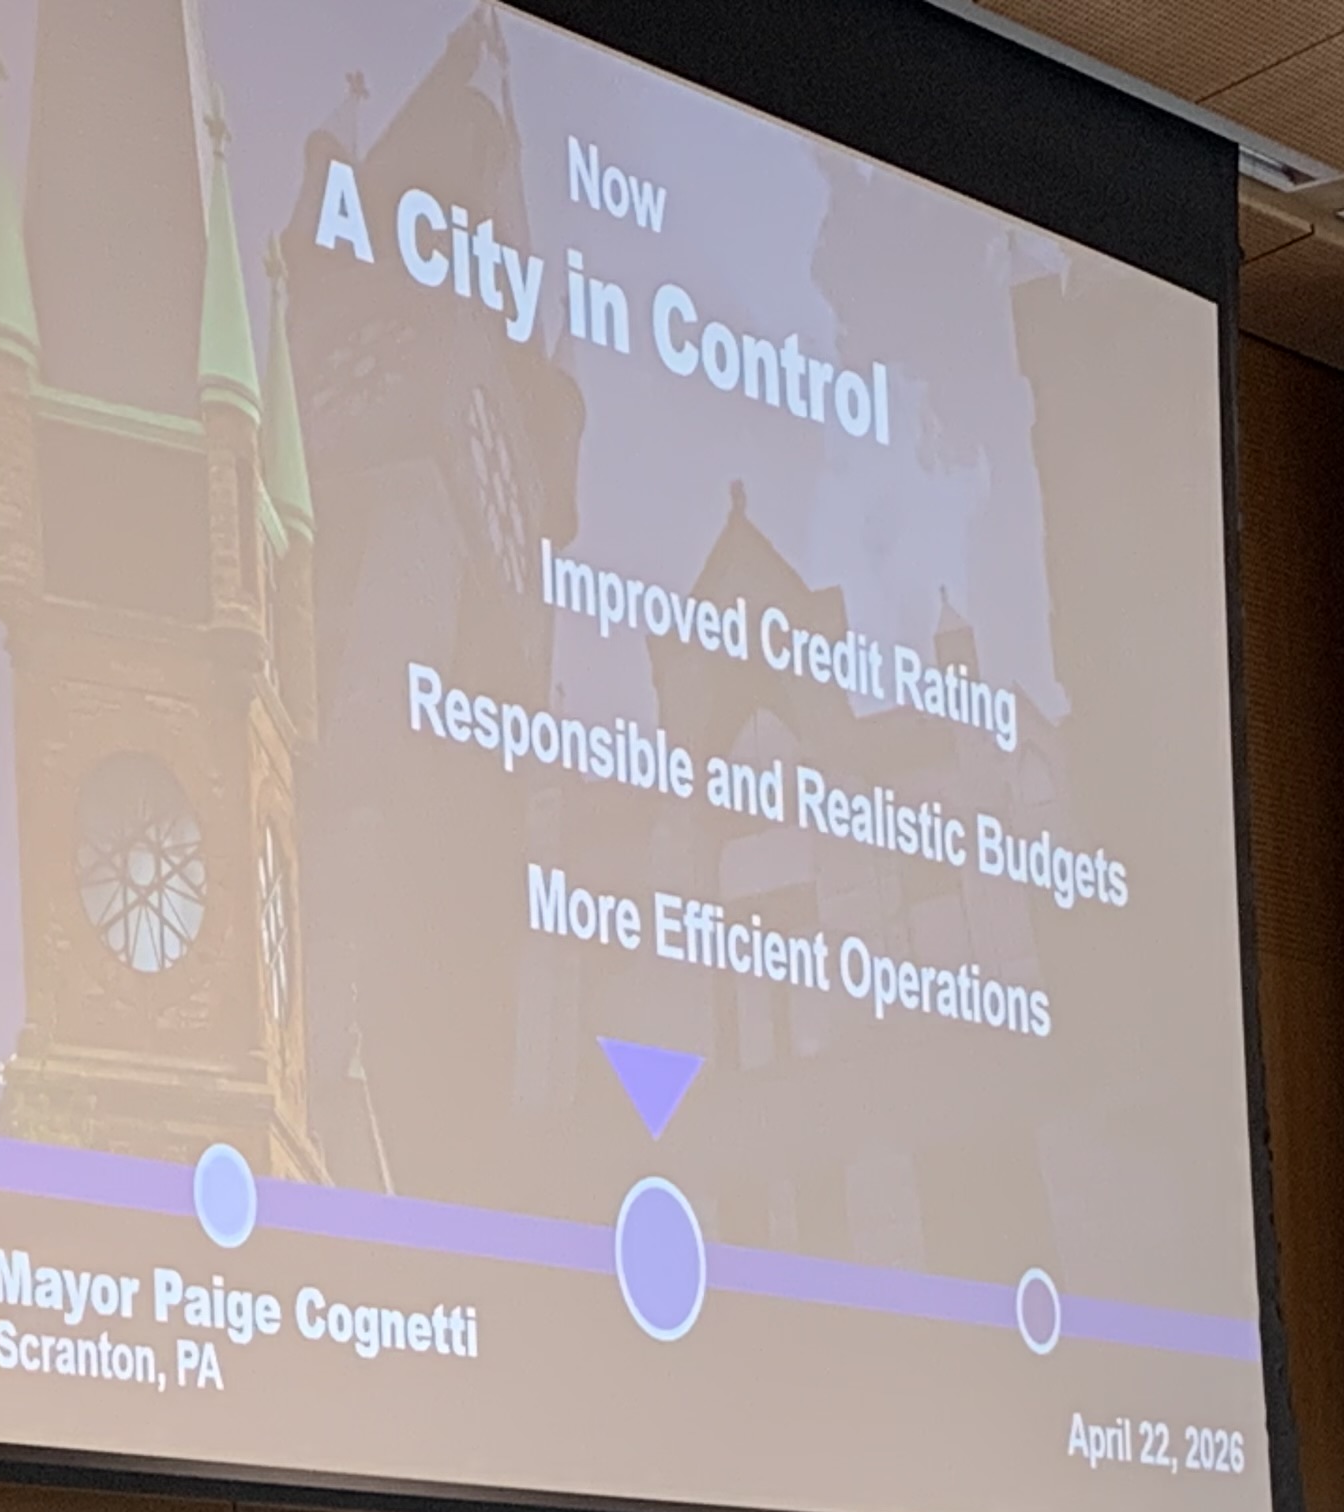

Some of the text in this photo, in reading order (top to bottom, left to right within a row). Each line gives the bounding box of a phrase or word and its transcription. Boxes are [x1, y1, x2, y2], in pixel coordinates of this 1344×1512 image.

[567, 135, 668, 234] Now
[315, 159, 891, 446] A City in Control
[541, 537, 1019, 752] Improved Credit Rating
[408, 661, 1130, 909] Responsible and Realistic Budgets
[527, 862, 1052, 1038] More Efficient Operations
[154, 1267, 282, 1345] Paige
[295, 1286, 479, 1359] Cognetti
[177, 1340, 225, 1391] PA
[1067, 1411, 1246, 1475] April 22, 2026
